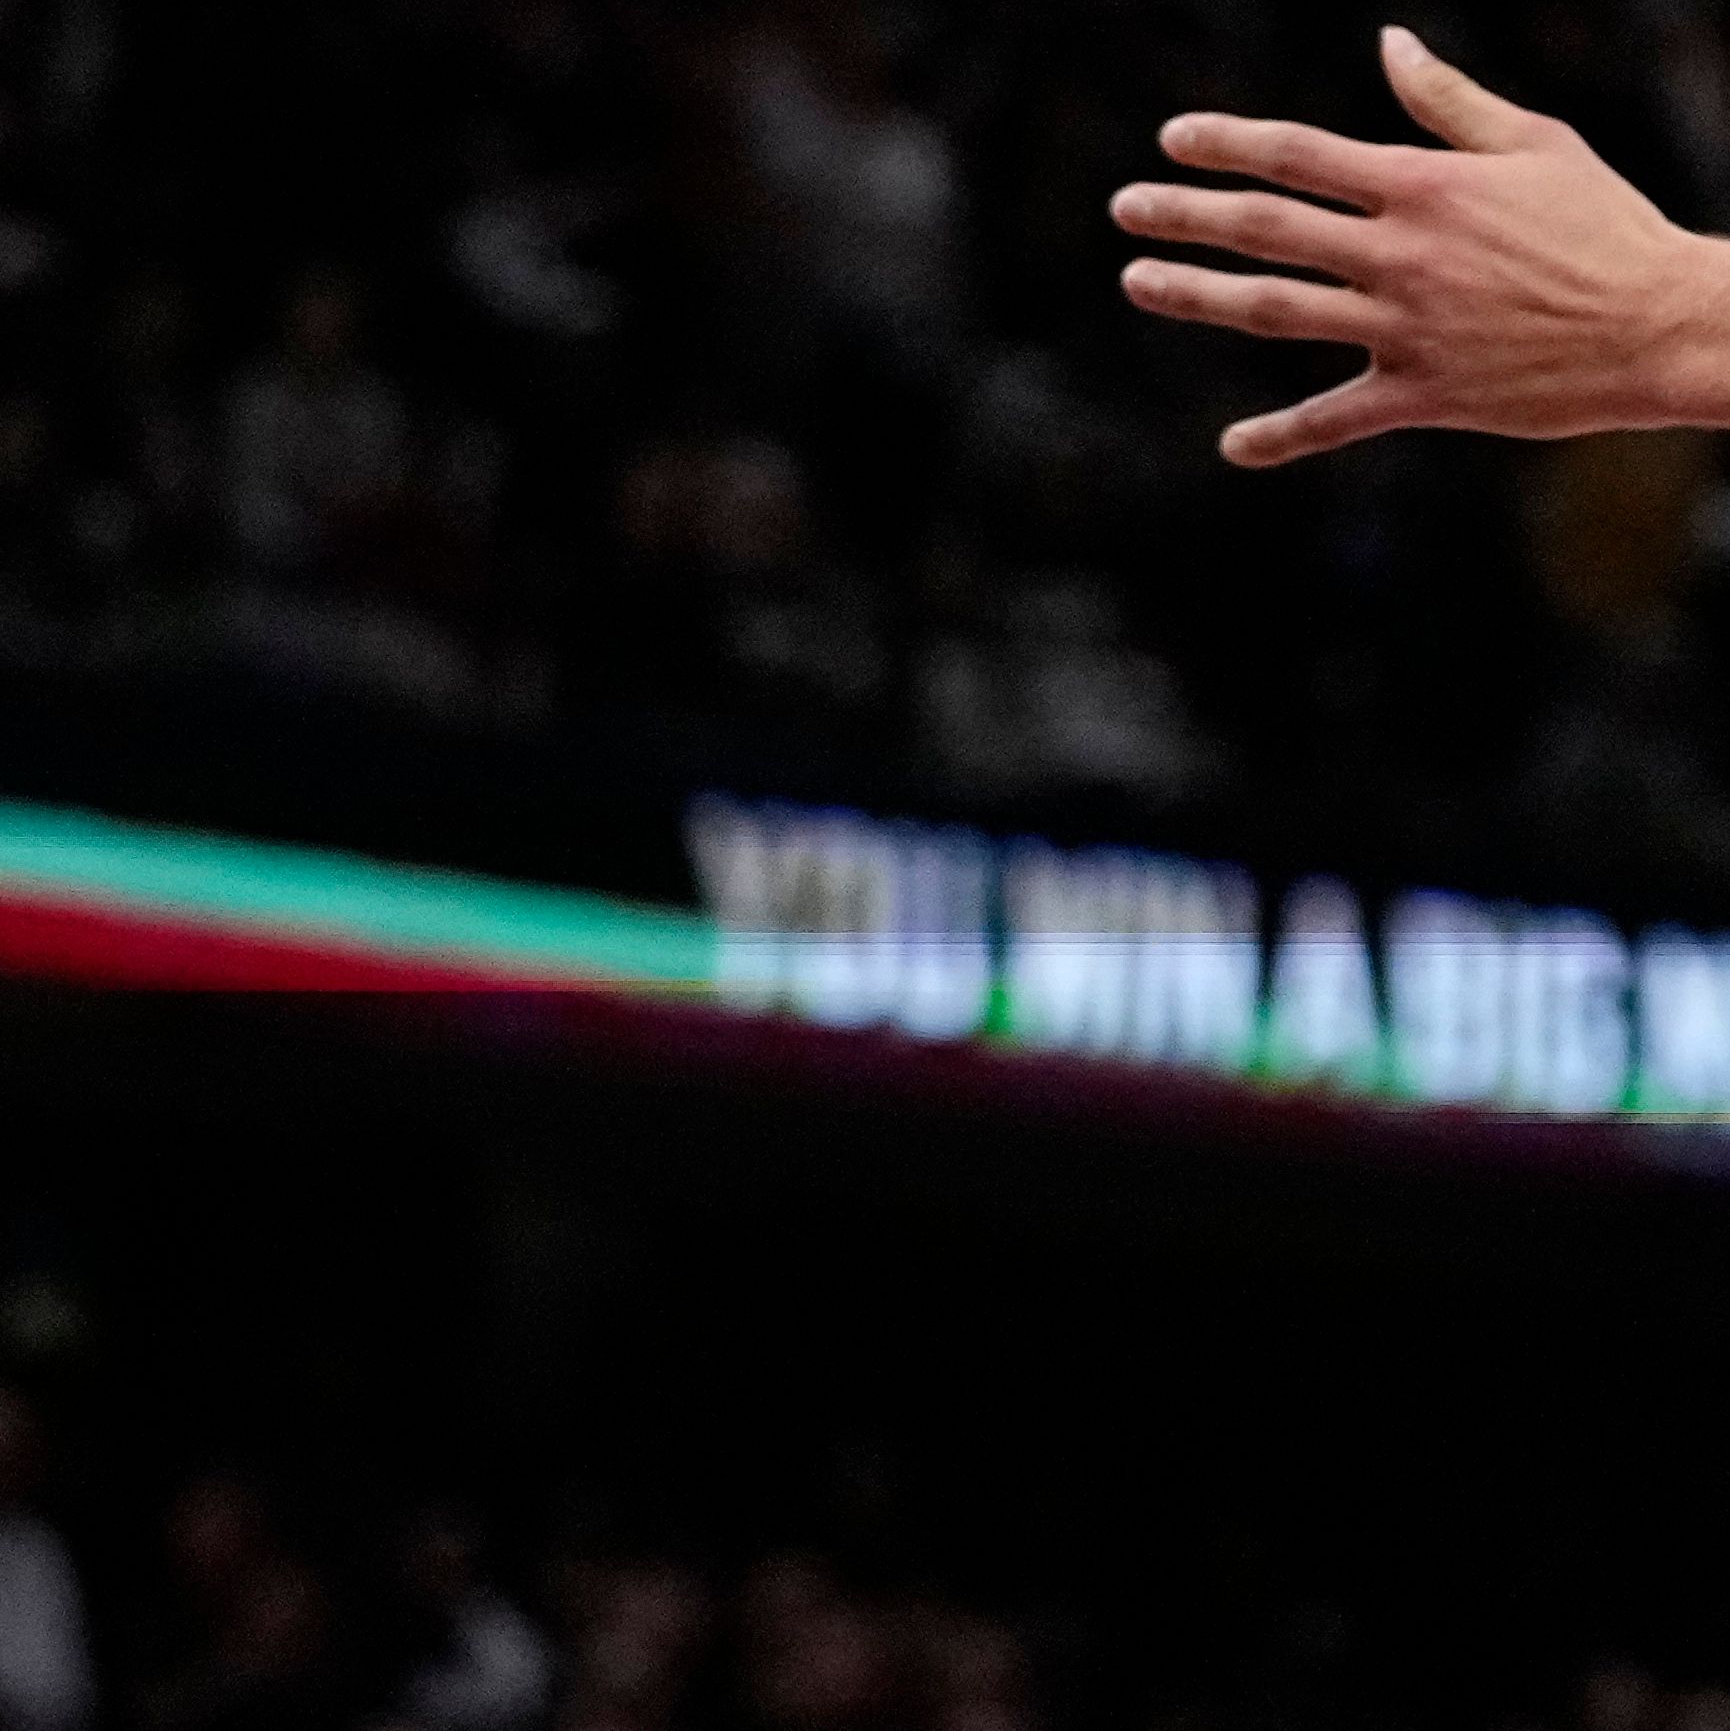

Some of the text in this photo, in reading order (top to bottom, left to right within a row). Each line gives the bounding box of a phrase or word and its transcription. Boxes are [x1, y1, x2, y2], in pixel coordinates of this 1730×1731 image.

[684, 792, 988, 1042] YOU
[1003, 834, 1260, 1072] WIN
[1266, 872, 1390, 1096] A
[1385, 884, 1626, 1116] BIG
